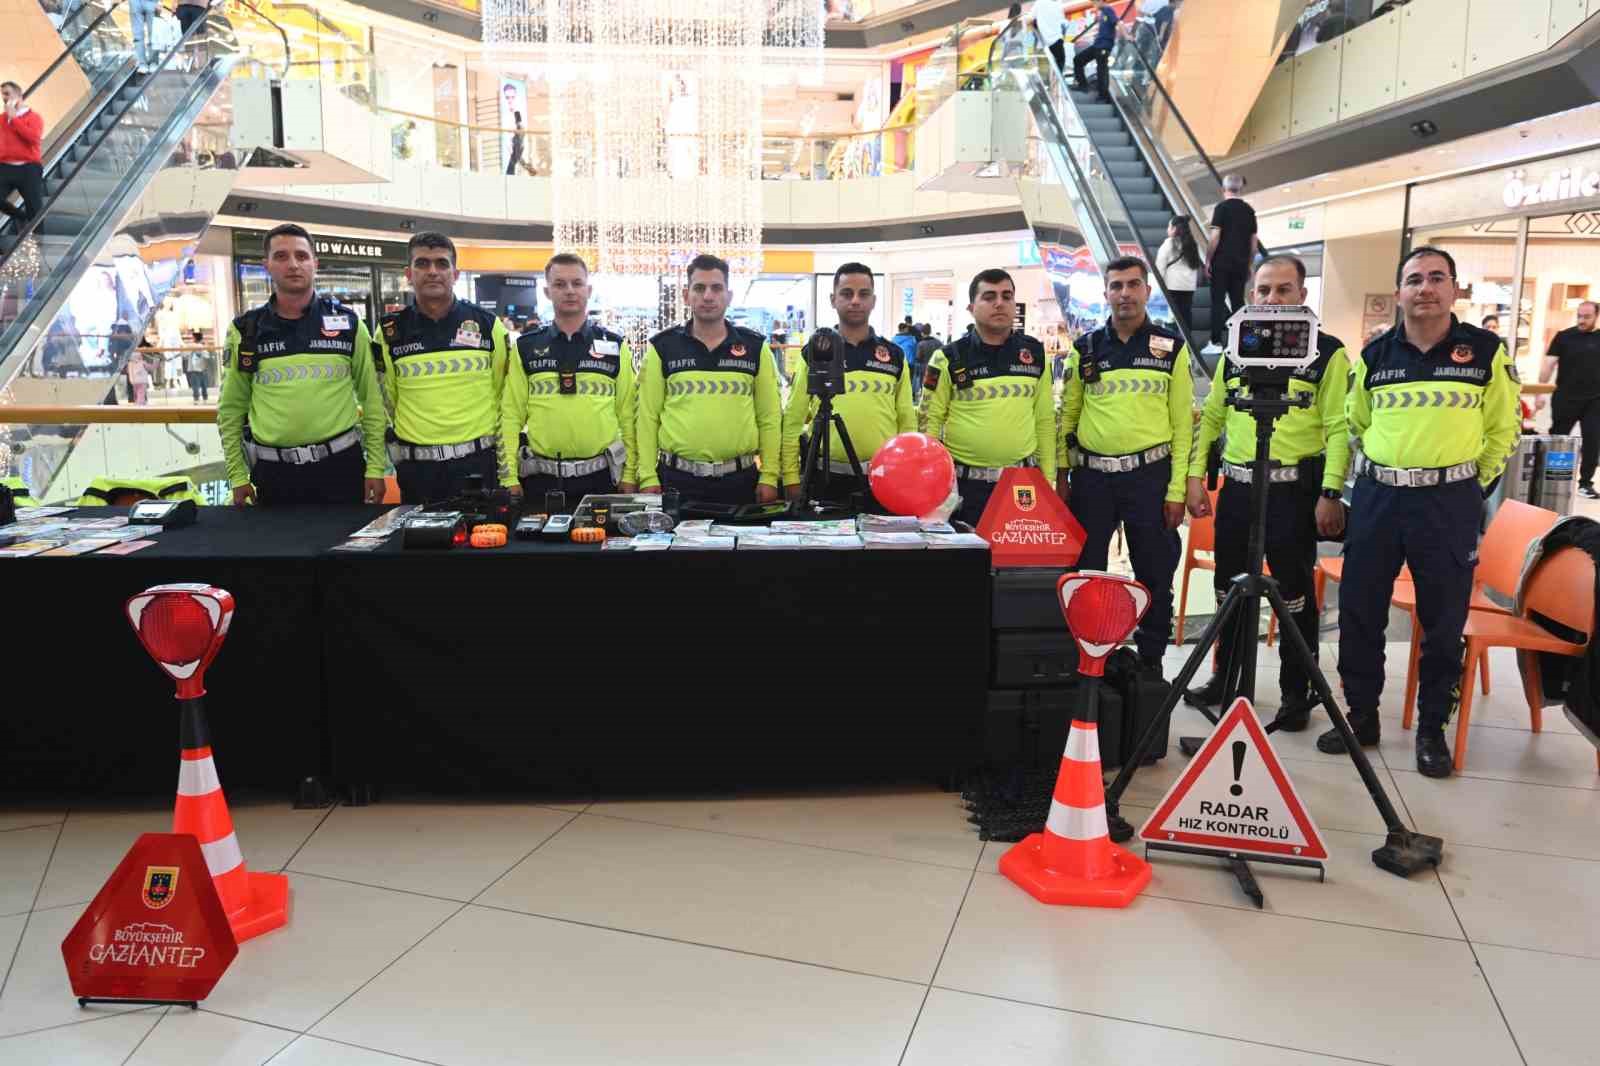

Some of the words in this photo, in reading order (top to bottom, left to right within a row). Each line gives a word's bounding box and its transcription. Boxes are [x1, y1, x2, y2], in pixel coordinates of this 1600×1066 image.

[330, 243, 382, 256] WALKER
[1200, 801, 1268, 821] RADAR
[1179, 817, 1202, 830] HIZ
[1206, 820, 1288, 839] KONTROLÜ
